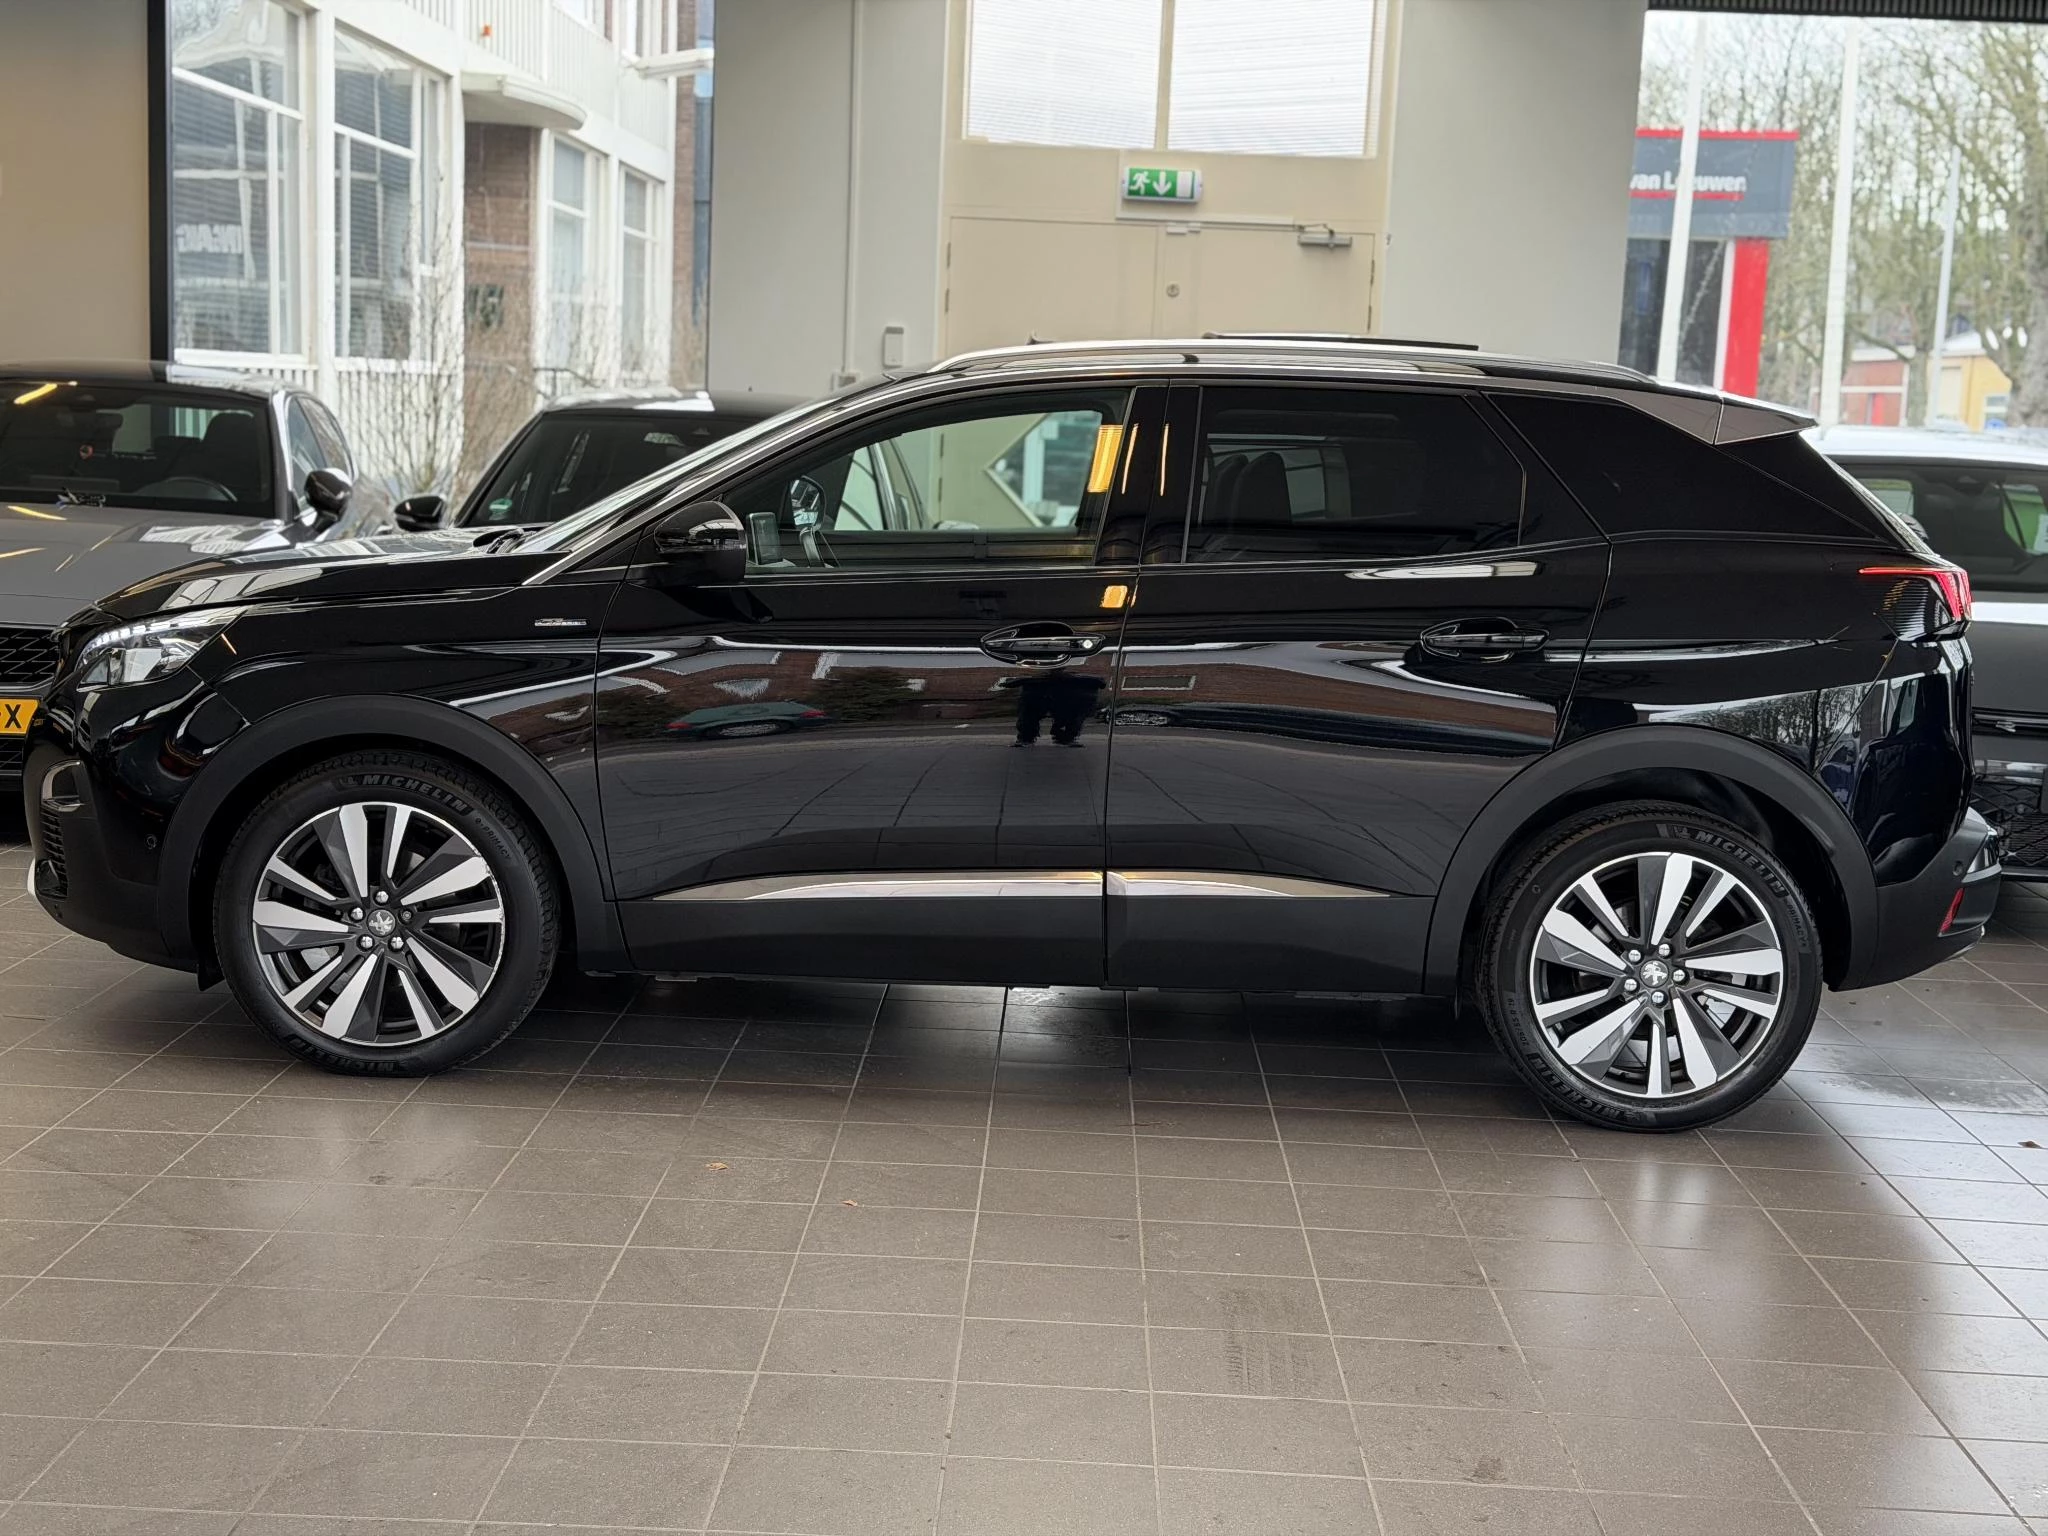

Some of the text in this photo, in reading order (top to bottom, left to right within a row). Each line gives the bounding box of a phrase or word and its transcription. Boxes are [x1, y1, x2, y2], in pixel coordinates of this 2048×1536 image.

[1663, 169, 1747, 192] Luwen
[361, 774, 469, 812] MICHELIN
[1695, 830, 1787, 896] MICHELIN
[288, 1039, 394, 1071] MICHELIN
[1530, 1056, 1621, 1119] MICHELIN
